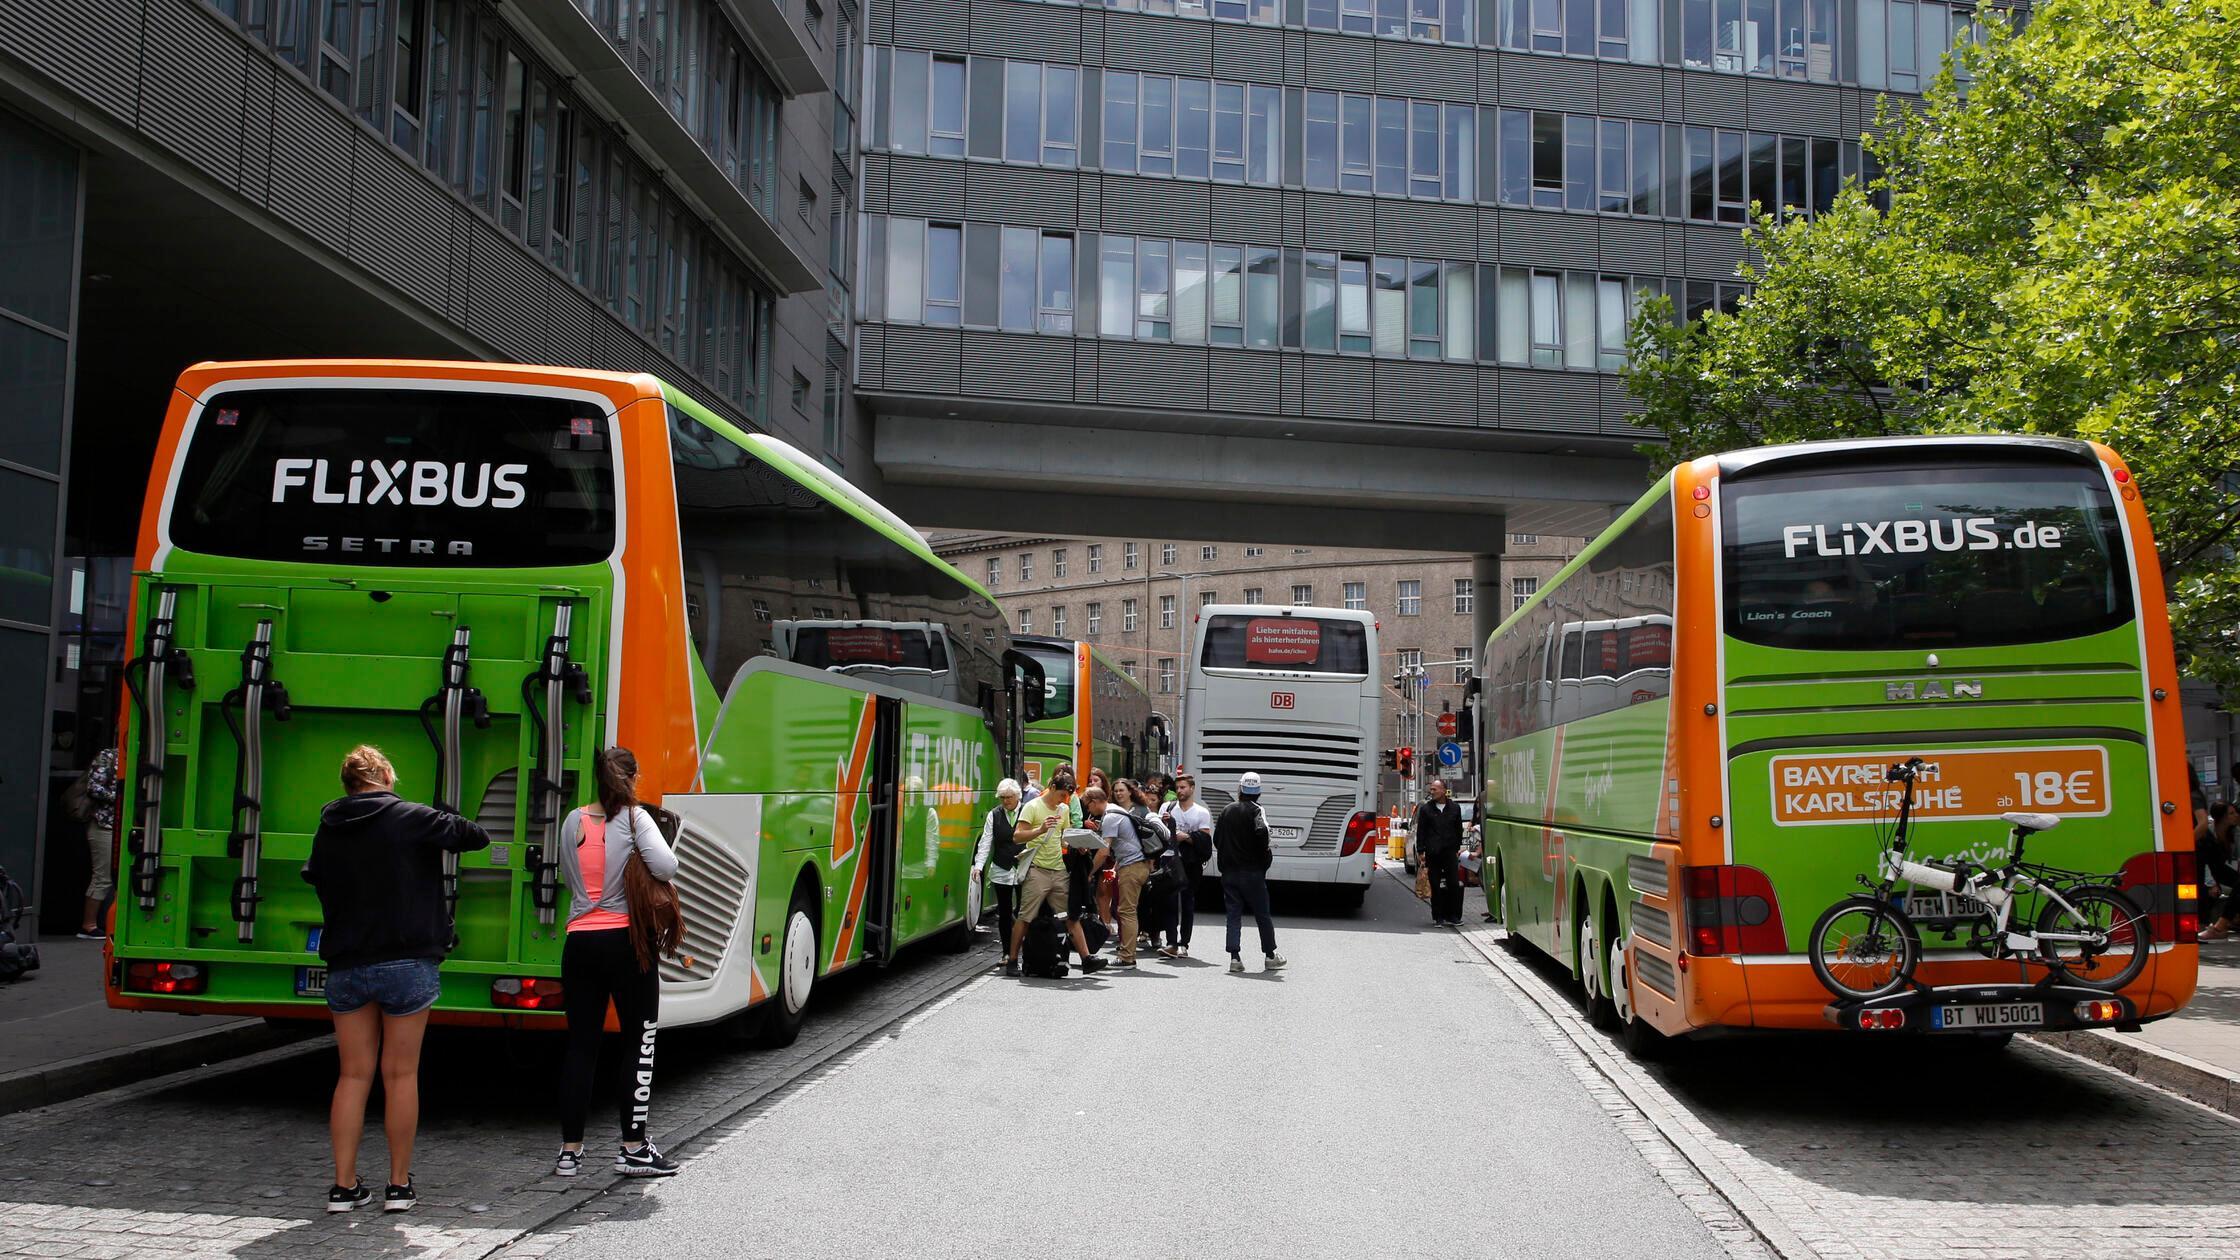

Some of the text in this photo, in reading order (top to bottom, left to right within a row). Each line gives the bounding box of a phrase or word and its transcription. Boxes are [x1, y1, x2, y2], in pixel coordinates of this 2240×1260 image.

[303, 536, 473, 556] SETRA
[1747, 609, 1832, 621] Lion's Coach
[1256, 626, 1318, 636] Lieber mitfahren
[1264, 637, 1320, 645] hinterherfahren
[1886, 680, 1982, 700] MAN
[1273, 695, 1292, 707] DB
[1783, 762, 1941, 787] BAYREH
[1996, 770, 2096, 807] ab 18€
[1943, 1007, 1964, 1026] BT
[1975, 1006, 1996, 1025] WU
[1999, 1005, 2041, 1023] 5001
[631, 1019, 658, 1130] JUST DO IT.
